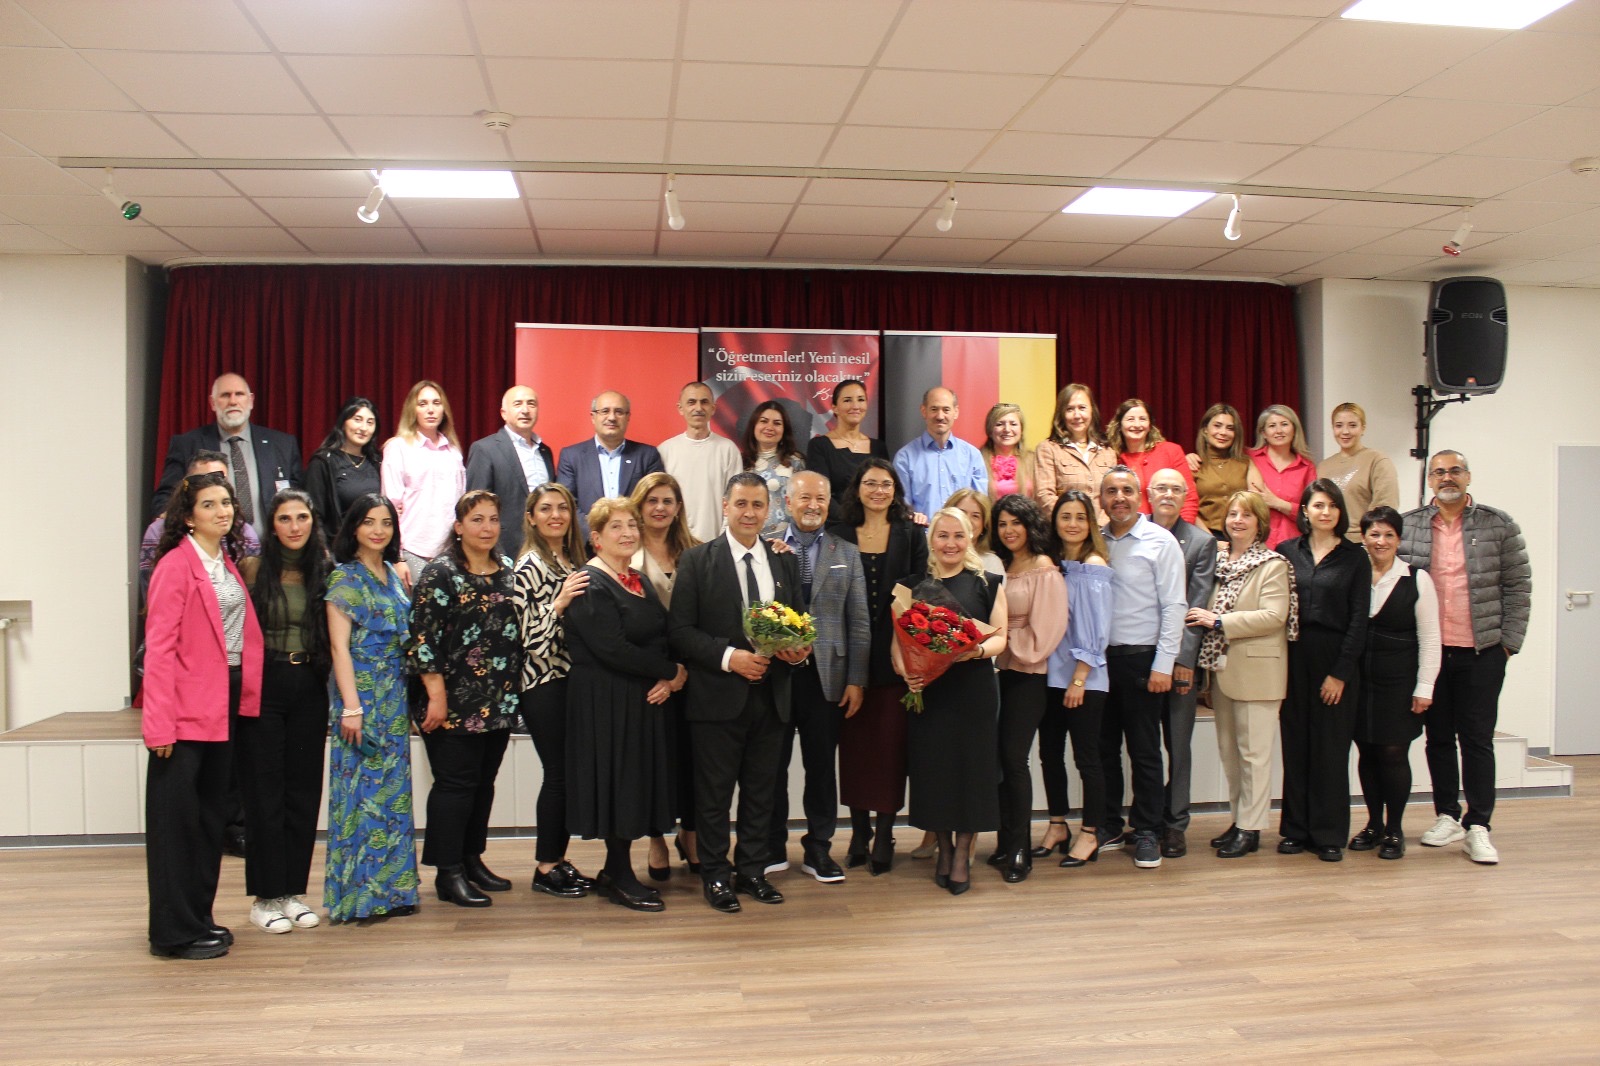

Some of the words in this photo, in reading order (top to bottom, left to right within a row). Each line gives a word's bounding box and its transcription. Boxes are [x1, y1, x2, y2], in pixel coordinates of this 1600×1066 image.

[808, 351, 837, 364] Yeni
[839, 352, 871, 365] nesil
[716, 369, 747, 382] sizin
[750, 370, 802, 382] eseriniz
